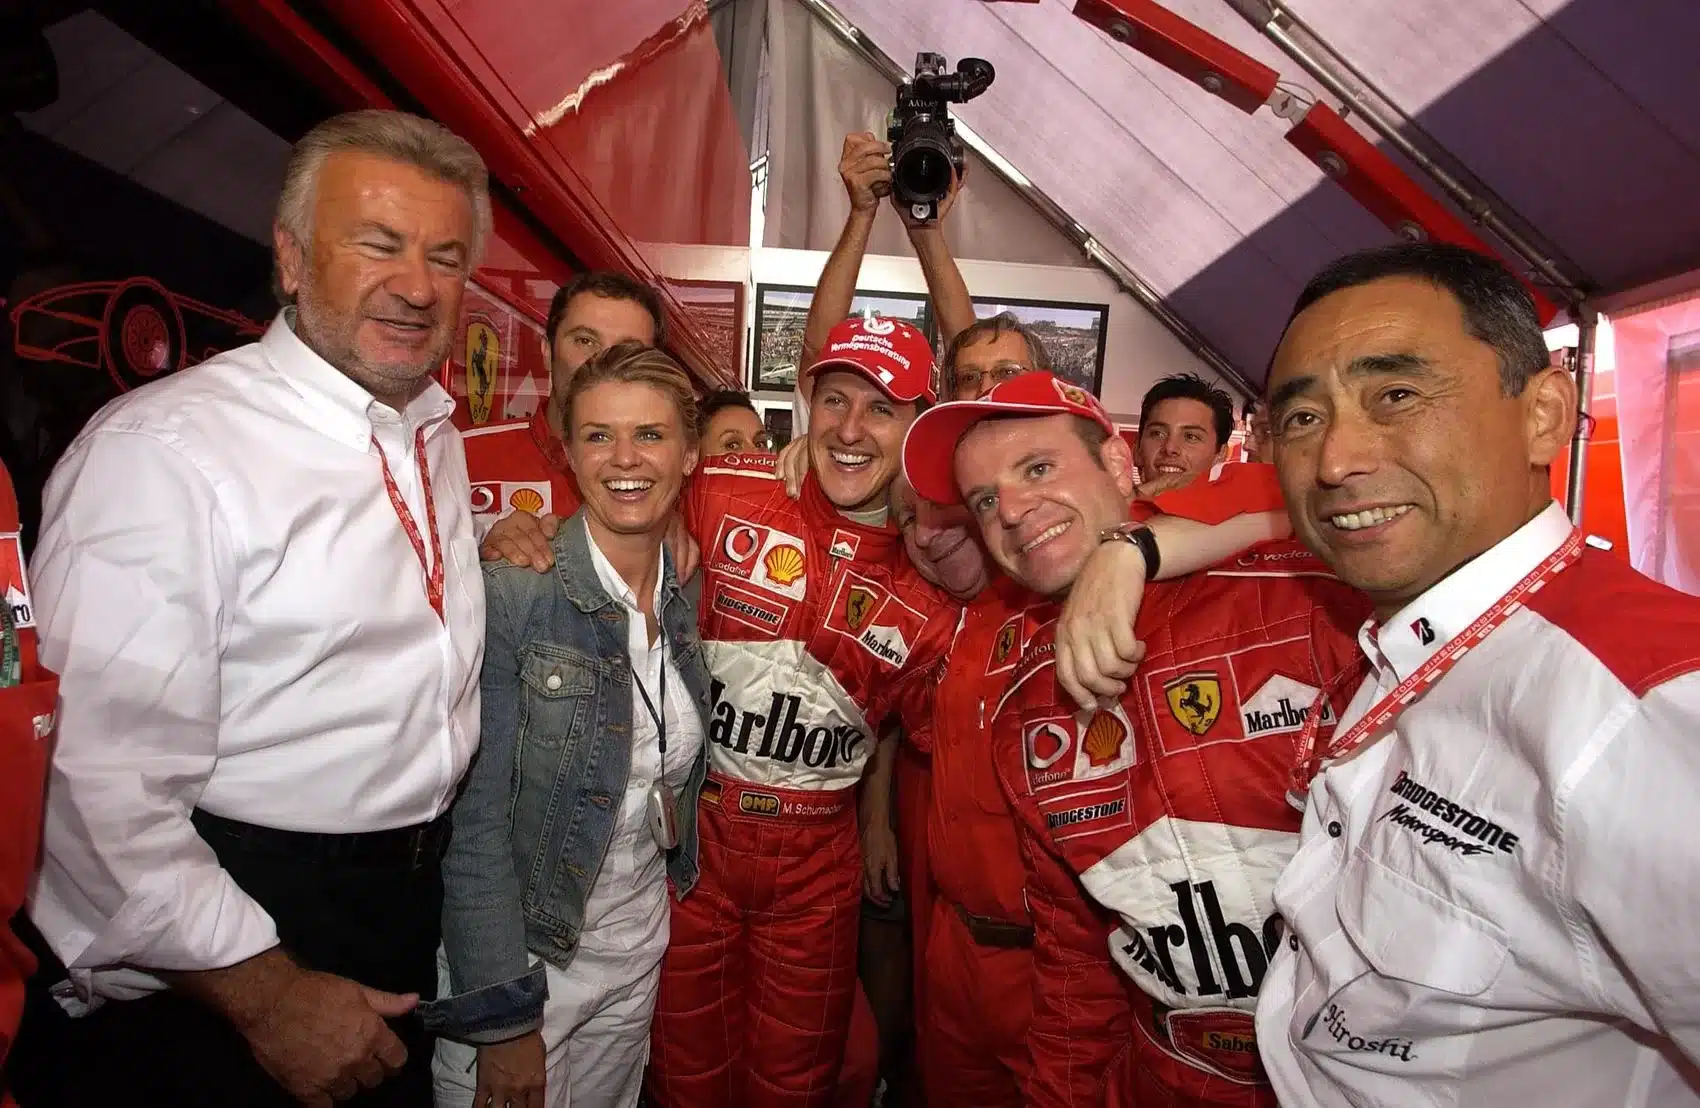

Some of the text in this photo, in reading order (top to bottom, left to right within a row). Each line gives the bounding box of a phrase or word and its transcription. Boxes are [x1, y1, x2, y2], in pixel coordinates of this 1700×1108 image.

[831, 341, 911, 370] Vermögensberatung
[851, 334, 894, 350] Deutsche
[743, 456, 777, 467] voda
[861, 630, 903, 665] Marlboro
[1244, 698, 1330, 734] Marlboo
[1390, 770, 1520, 854] BRIDGESTONE
[1208, 1032, 1257, 1052] Sabe
[1323, 1004, 1418, 1063] Hiroshi
